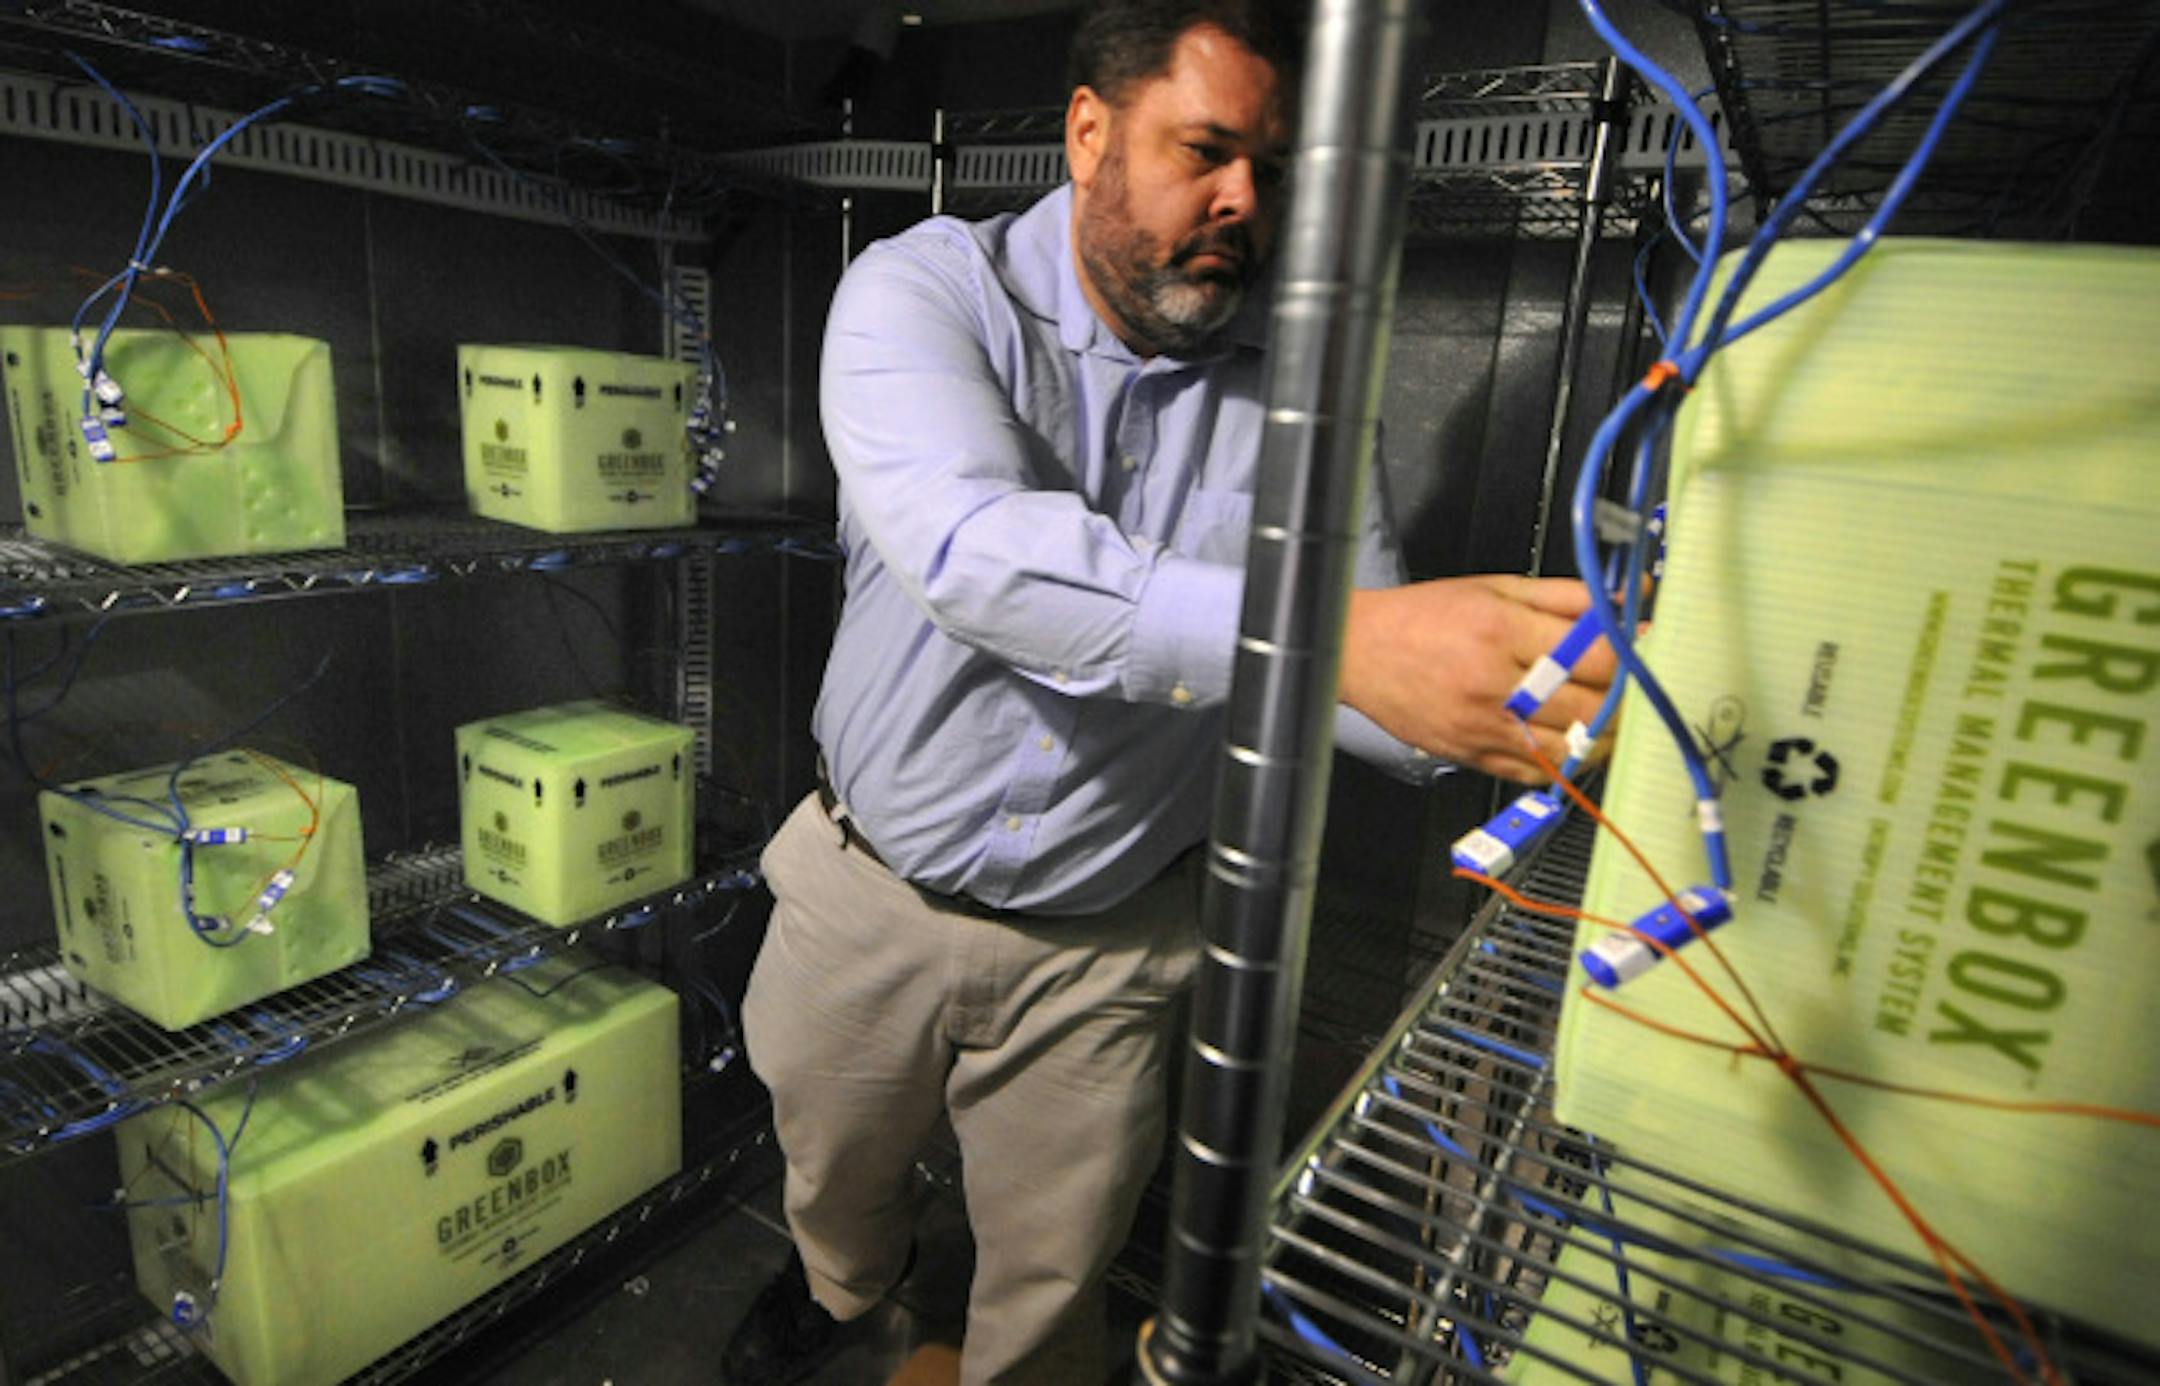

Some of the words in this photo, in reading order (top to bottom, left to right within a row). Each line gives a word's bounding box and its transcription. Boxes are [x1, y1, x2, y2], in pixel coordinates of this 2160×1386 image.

[1966, 558, 2039, 700] THERMAL
[1911, 711, 1996, 924] MANAGEMENT
[1928, 566, 2160, 1074] GREENBOX
[1873, 928, 1937, 1037] SYSTEM
[437, 1150, 572, 1244] GREENBOX
